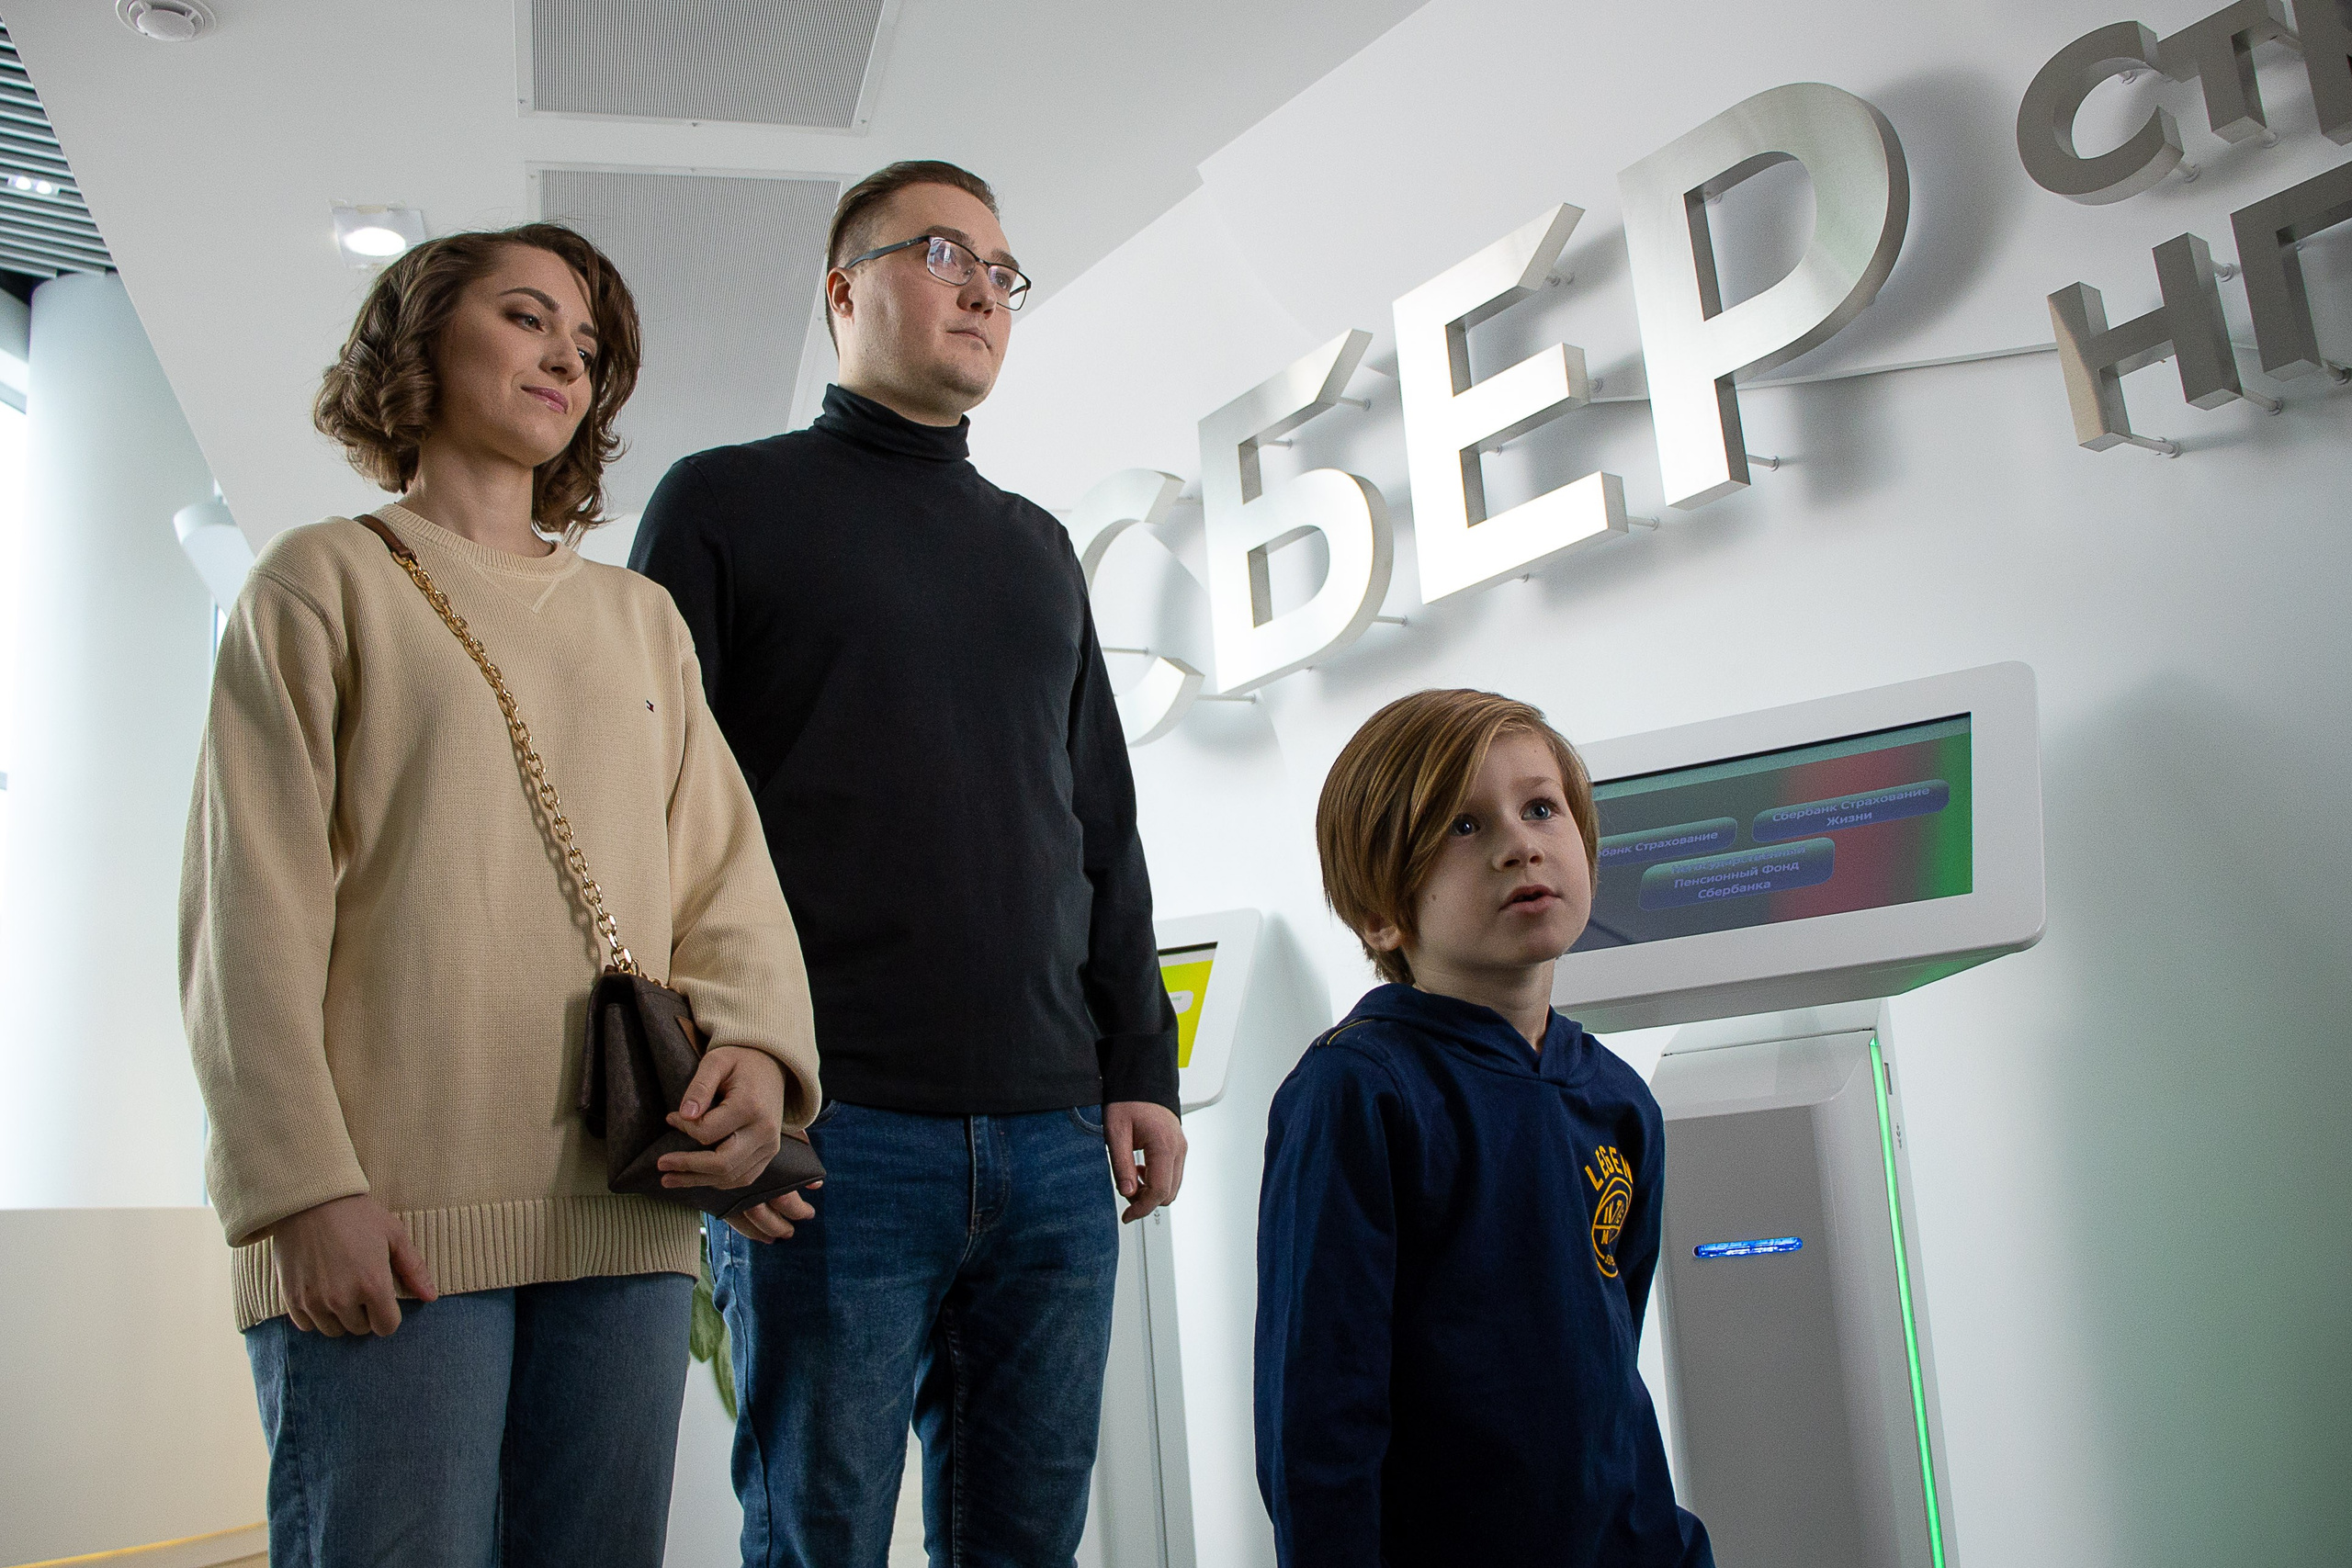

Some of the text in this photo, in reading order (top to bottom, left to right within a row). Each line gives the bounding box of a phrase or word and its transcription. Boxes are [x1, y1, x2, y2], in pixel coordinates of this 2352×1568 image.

[2016, 0, 2352, 207] СТ
[1068, 81, 1910, 750] СБЕР
[1771, 786, 1930, 822] Сбербанк Страхование
[1826, 811, 1873, 827] Жизни
[1634, 831, 1719, 852] Страхование
[1673, 861, 1800, 888] Пенсионный Фонд
[1697, 880, 1771, 899] Сбербанка
